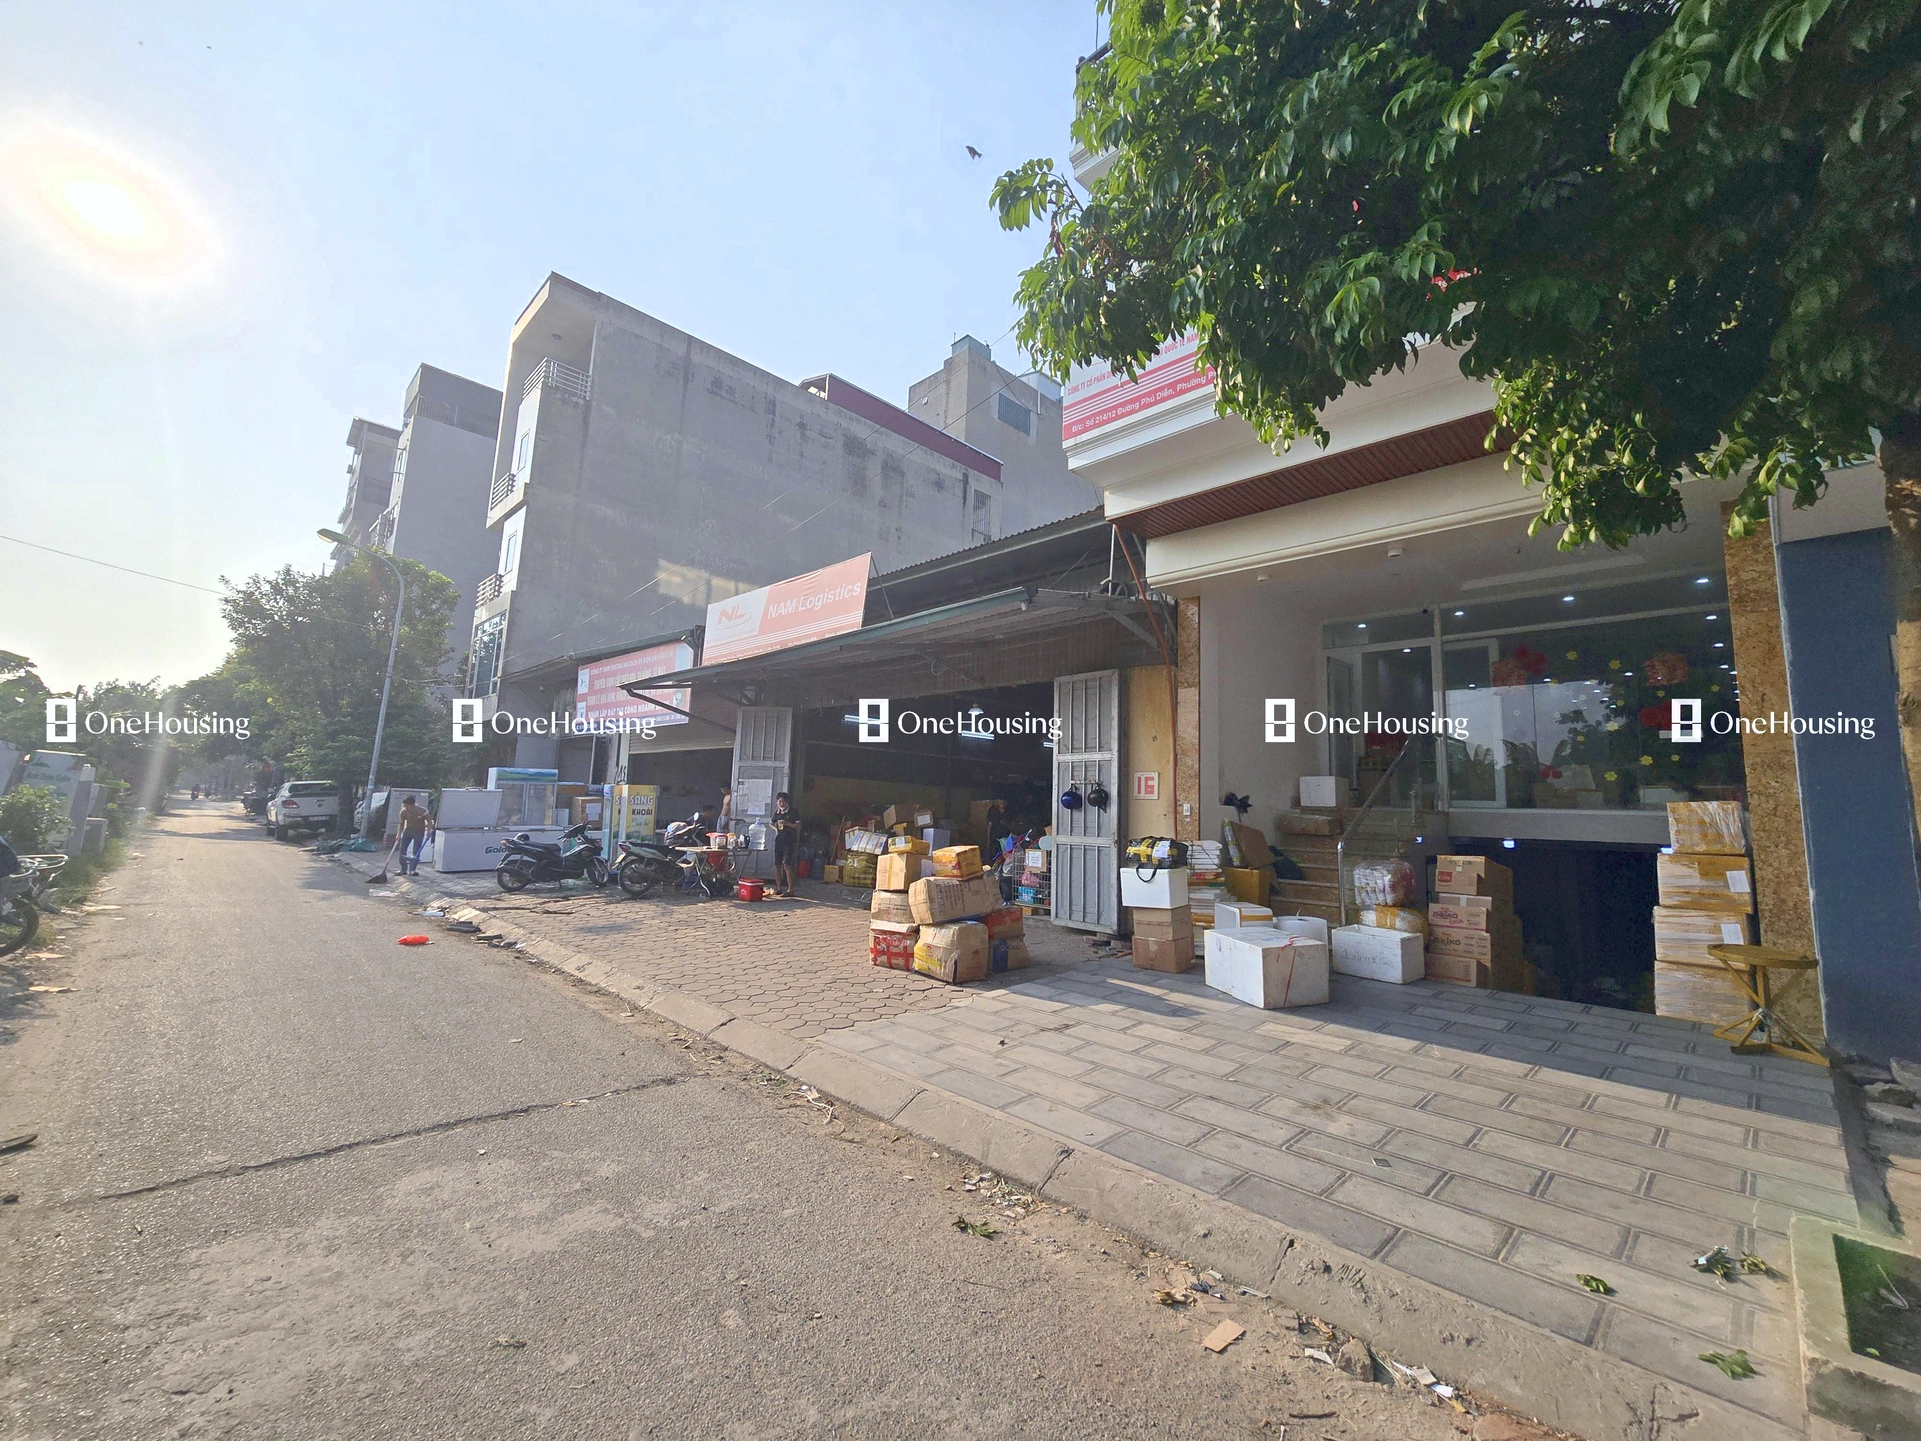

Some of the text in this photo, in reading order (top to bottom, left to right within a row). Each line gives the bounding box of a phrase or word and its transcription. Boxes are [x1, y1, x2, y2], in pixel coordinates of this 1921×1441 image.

[1095, 410, 1116, 424] 214/12
[1177, 375, 1206, 391] Phường
[767, 581, 862, 620] NAM Logistics
[1137, 776, 1155, 795] 16
